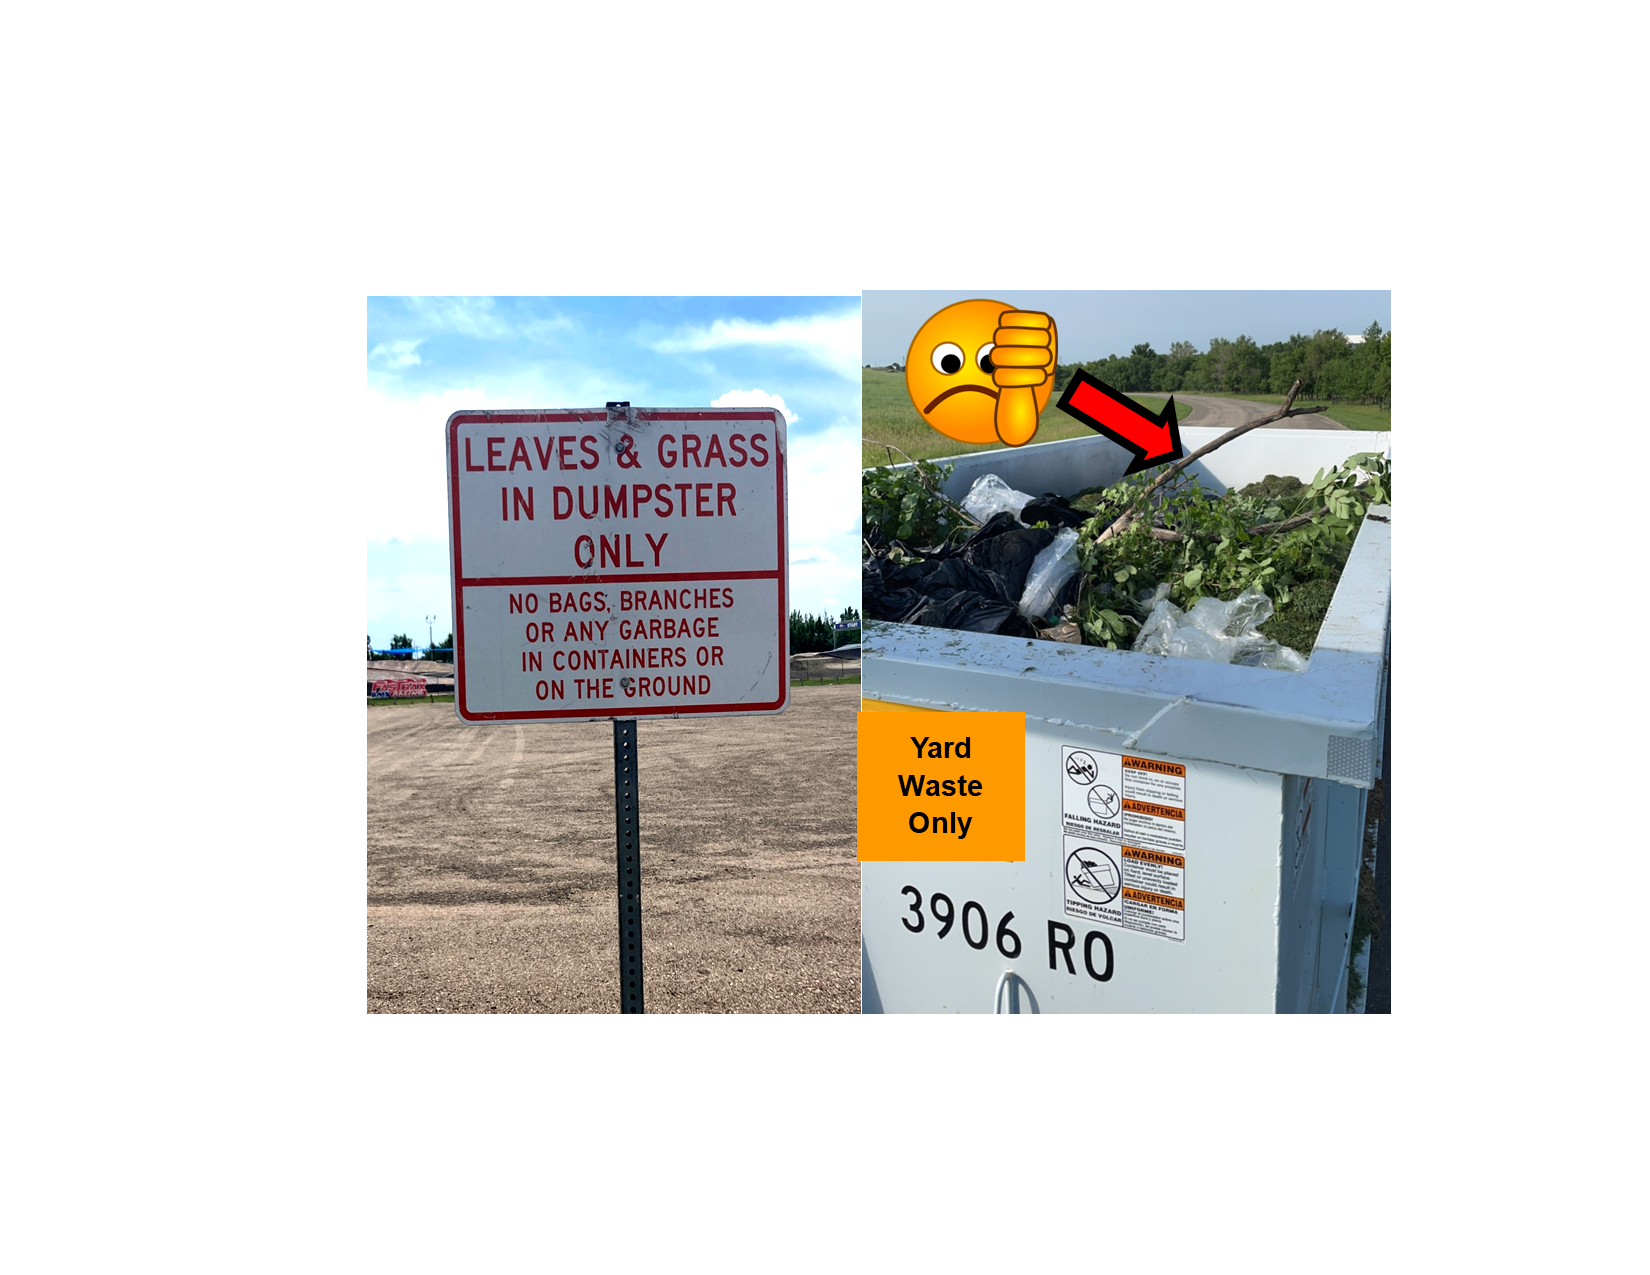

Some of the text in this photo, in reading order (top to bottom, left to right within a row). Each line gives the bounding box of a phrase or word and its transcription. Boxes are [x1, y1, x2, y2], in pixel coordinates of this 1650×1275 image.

[465, 434, 769, 472] LEAVES & GRASS
[502, 483, 737, 521] IN DUMPSTER
[574, 533, 668, 568] ONLY
[509, 588, 734, 614] NO BAGS, BRANCHES
[526, 617, 719, 643] OR ANY GARBAGE
[522, 646, 724, 672] IN CONTAINERS OR
[535, 675, 711, 700] ON THE GROUND
[1131, 759, 1183, 775] WARNING
[1131, 802, 1183, 819] ADVERTENCIA
[1064, 813, 1121, 829] FALLING HAZARD
[1065, 821, 1084, 829] RIESGO
[1093, 826, 1120, 836] RESBALAR
[1124, 857, 1139, 865] LOAD
[1131, 850, 1183, 867] WARNING
[1066, 899, 1093, 910] TIPPING
[1093, 905, 1122, 916] HAZARD
[1132, 890, 1183, 909] ADVERTENCIA
[1066, 906, 1088, 915] RIESGO
[1098, 913, 1122, 923] VOLCAR
[1158, 906, 1178, 915] FORMA
[901, 885, 1022, 959] 3906
